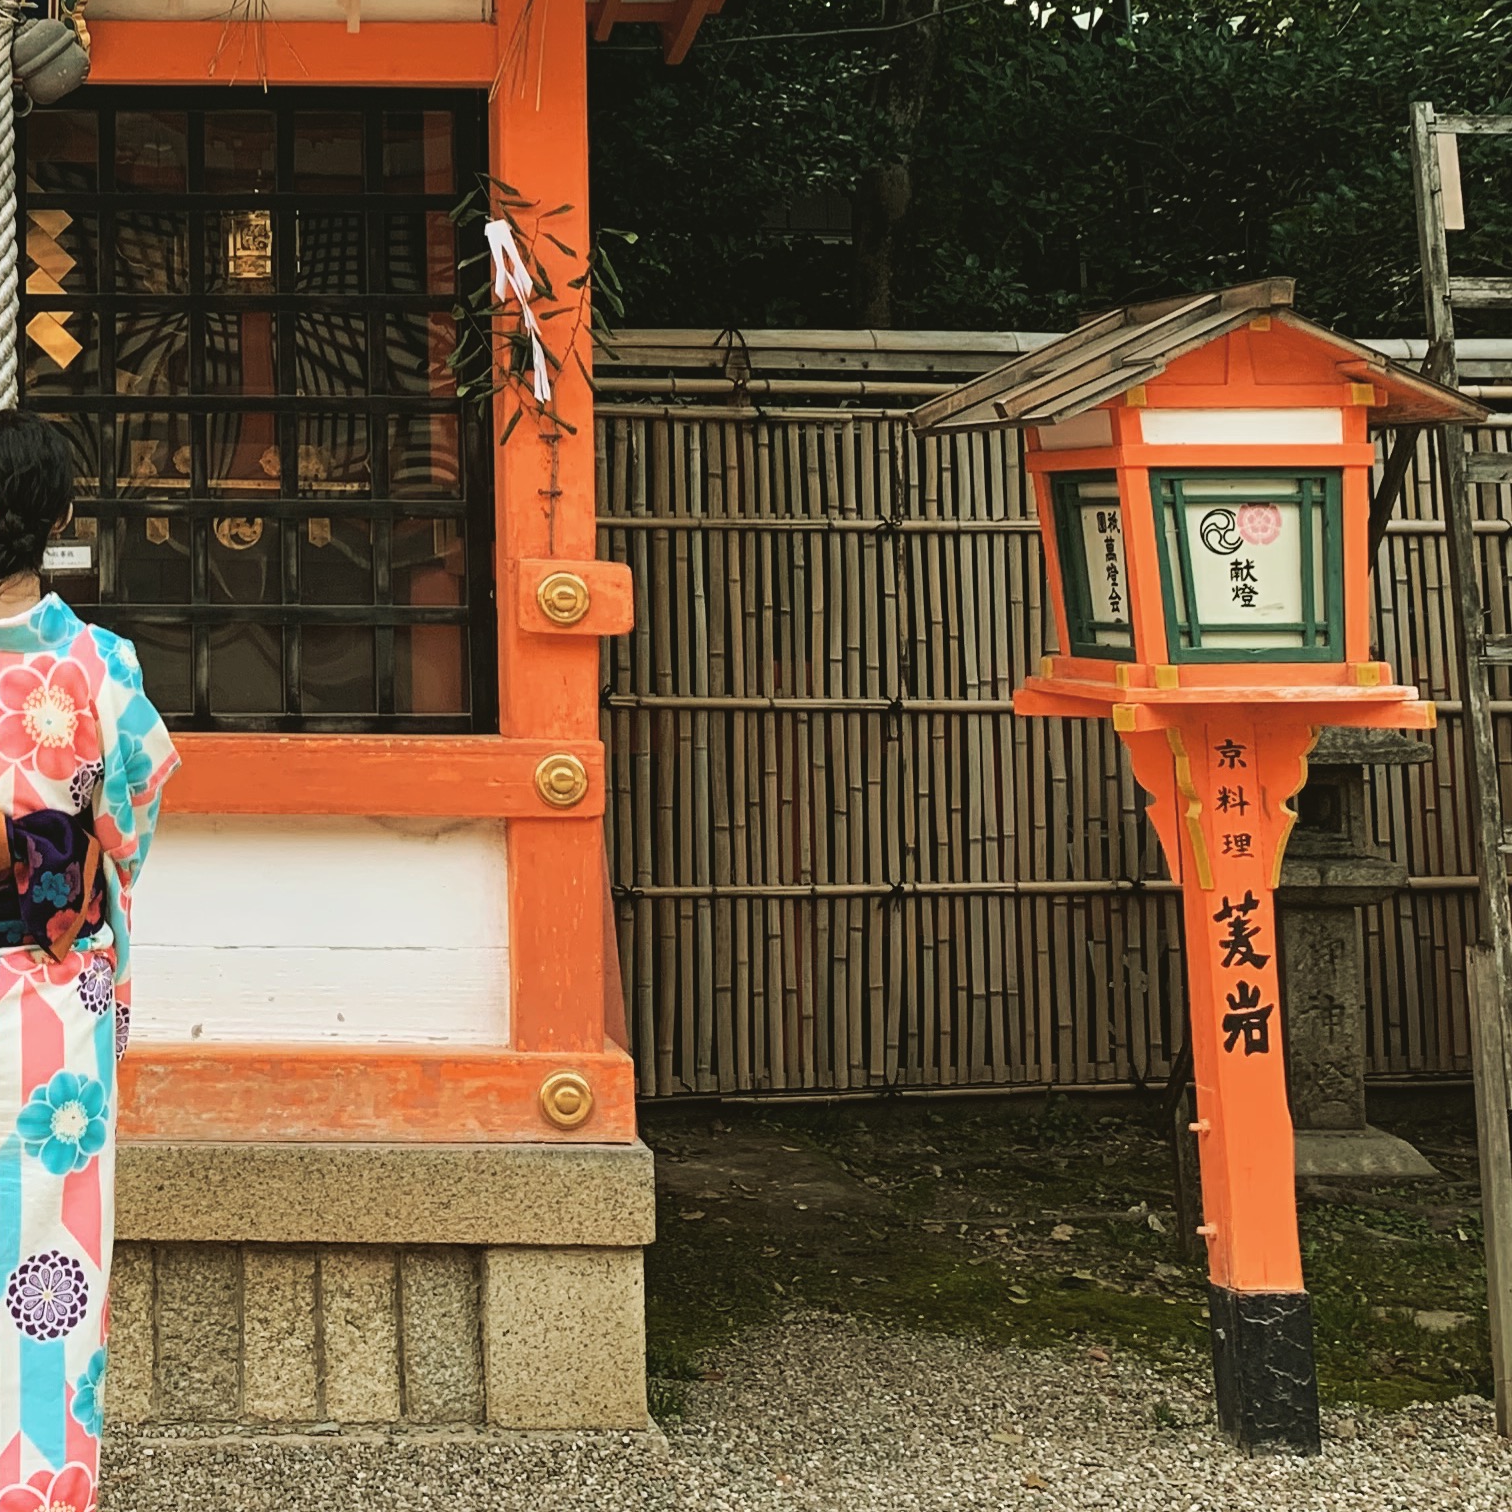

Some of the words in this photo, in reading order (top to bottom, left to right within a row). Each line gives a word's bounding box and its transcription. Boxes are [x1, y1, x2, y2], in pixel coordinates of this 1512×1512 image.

[1229, 558, 1259, 608] 献燈
[1214, 739, 1255, 858] 京料理
[1212, 890, 1275, 1058] 菱岩
